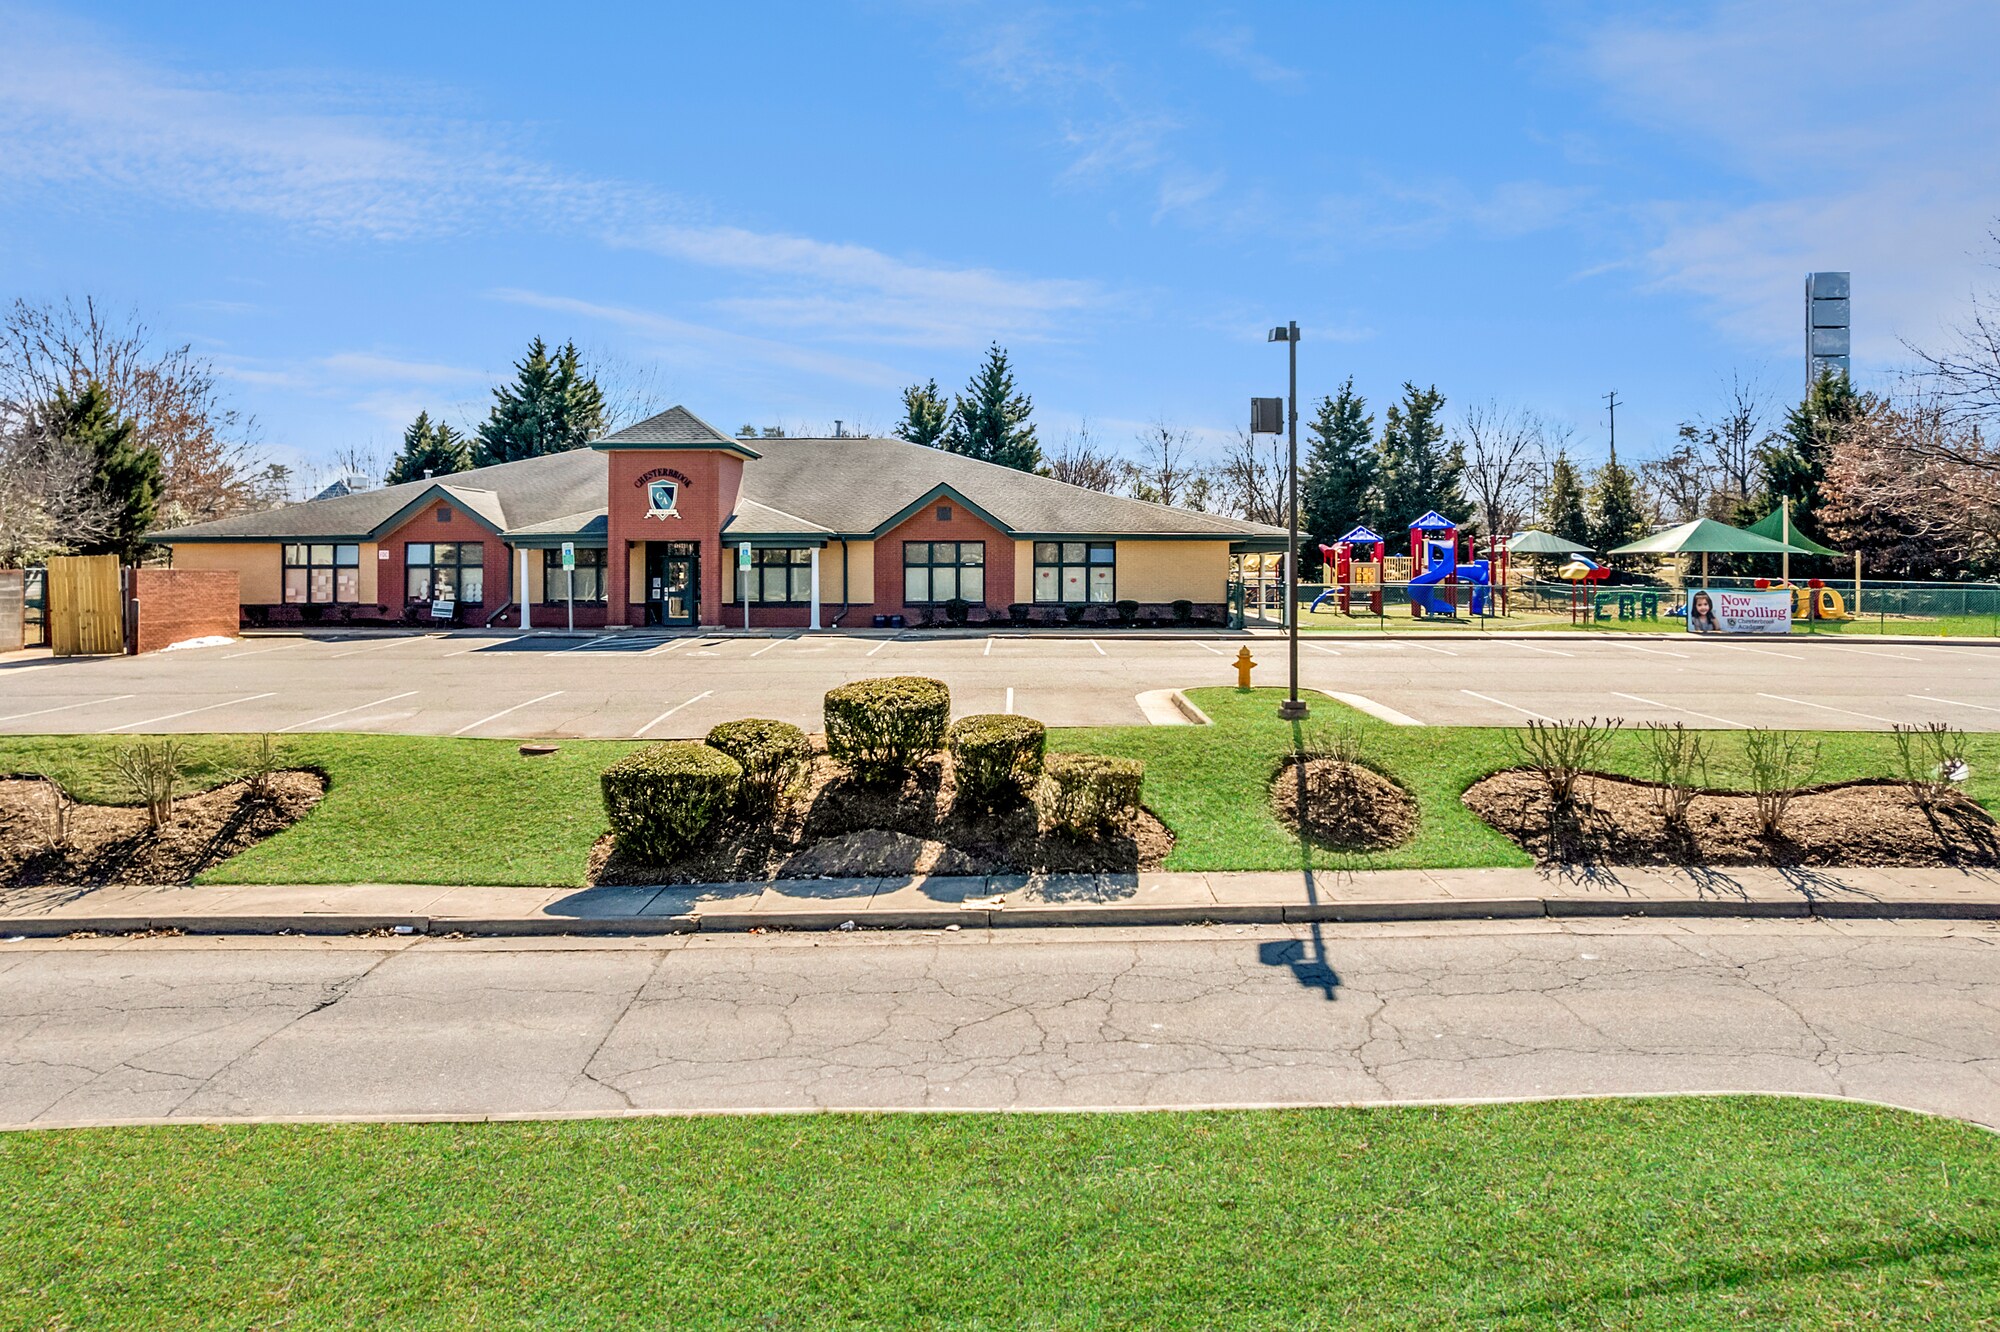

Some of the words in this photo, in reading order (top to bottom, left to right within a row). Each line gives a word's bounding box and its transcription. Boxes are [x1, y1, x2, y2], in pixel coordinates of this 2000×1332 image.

[634, 467, 692, 488] CHESTERBROOK
[1721, 595, 1751, 606] Now
[1721, 606, 1787, 620] Enrolling
